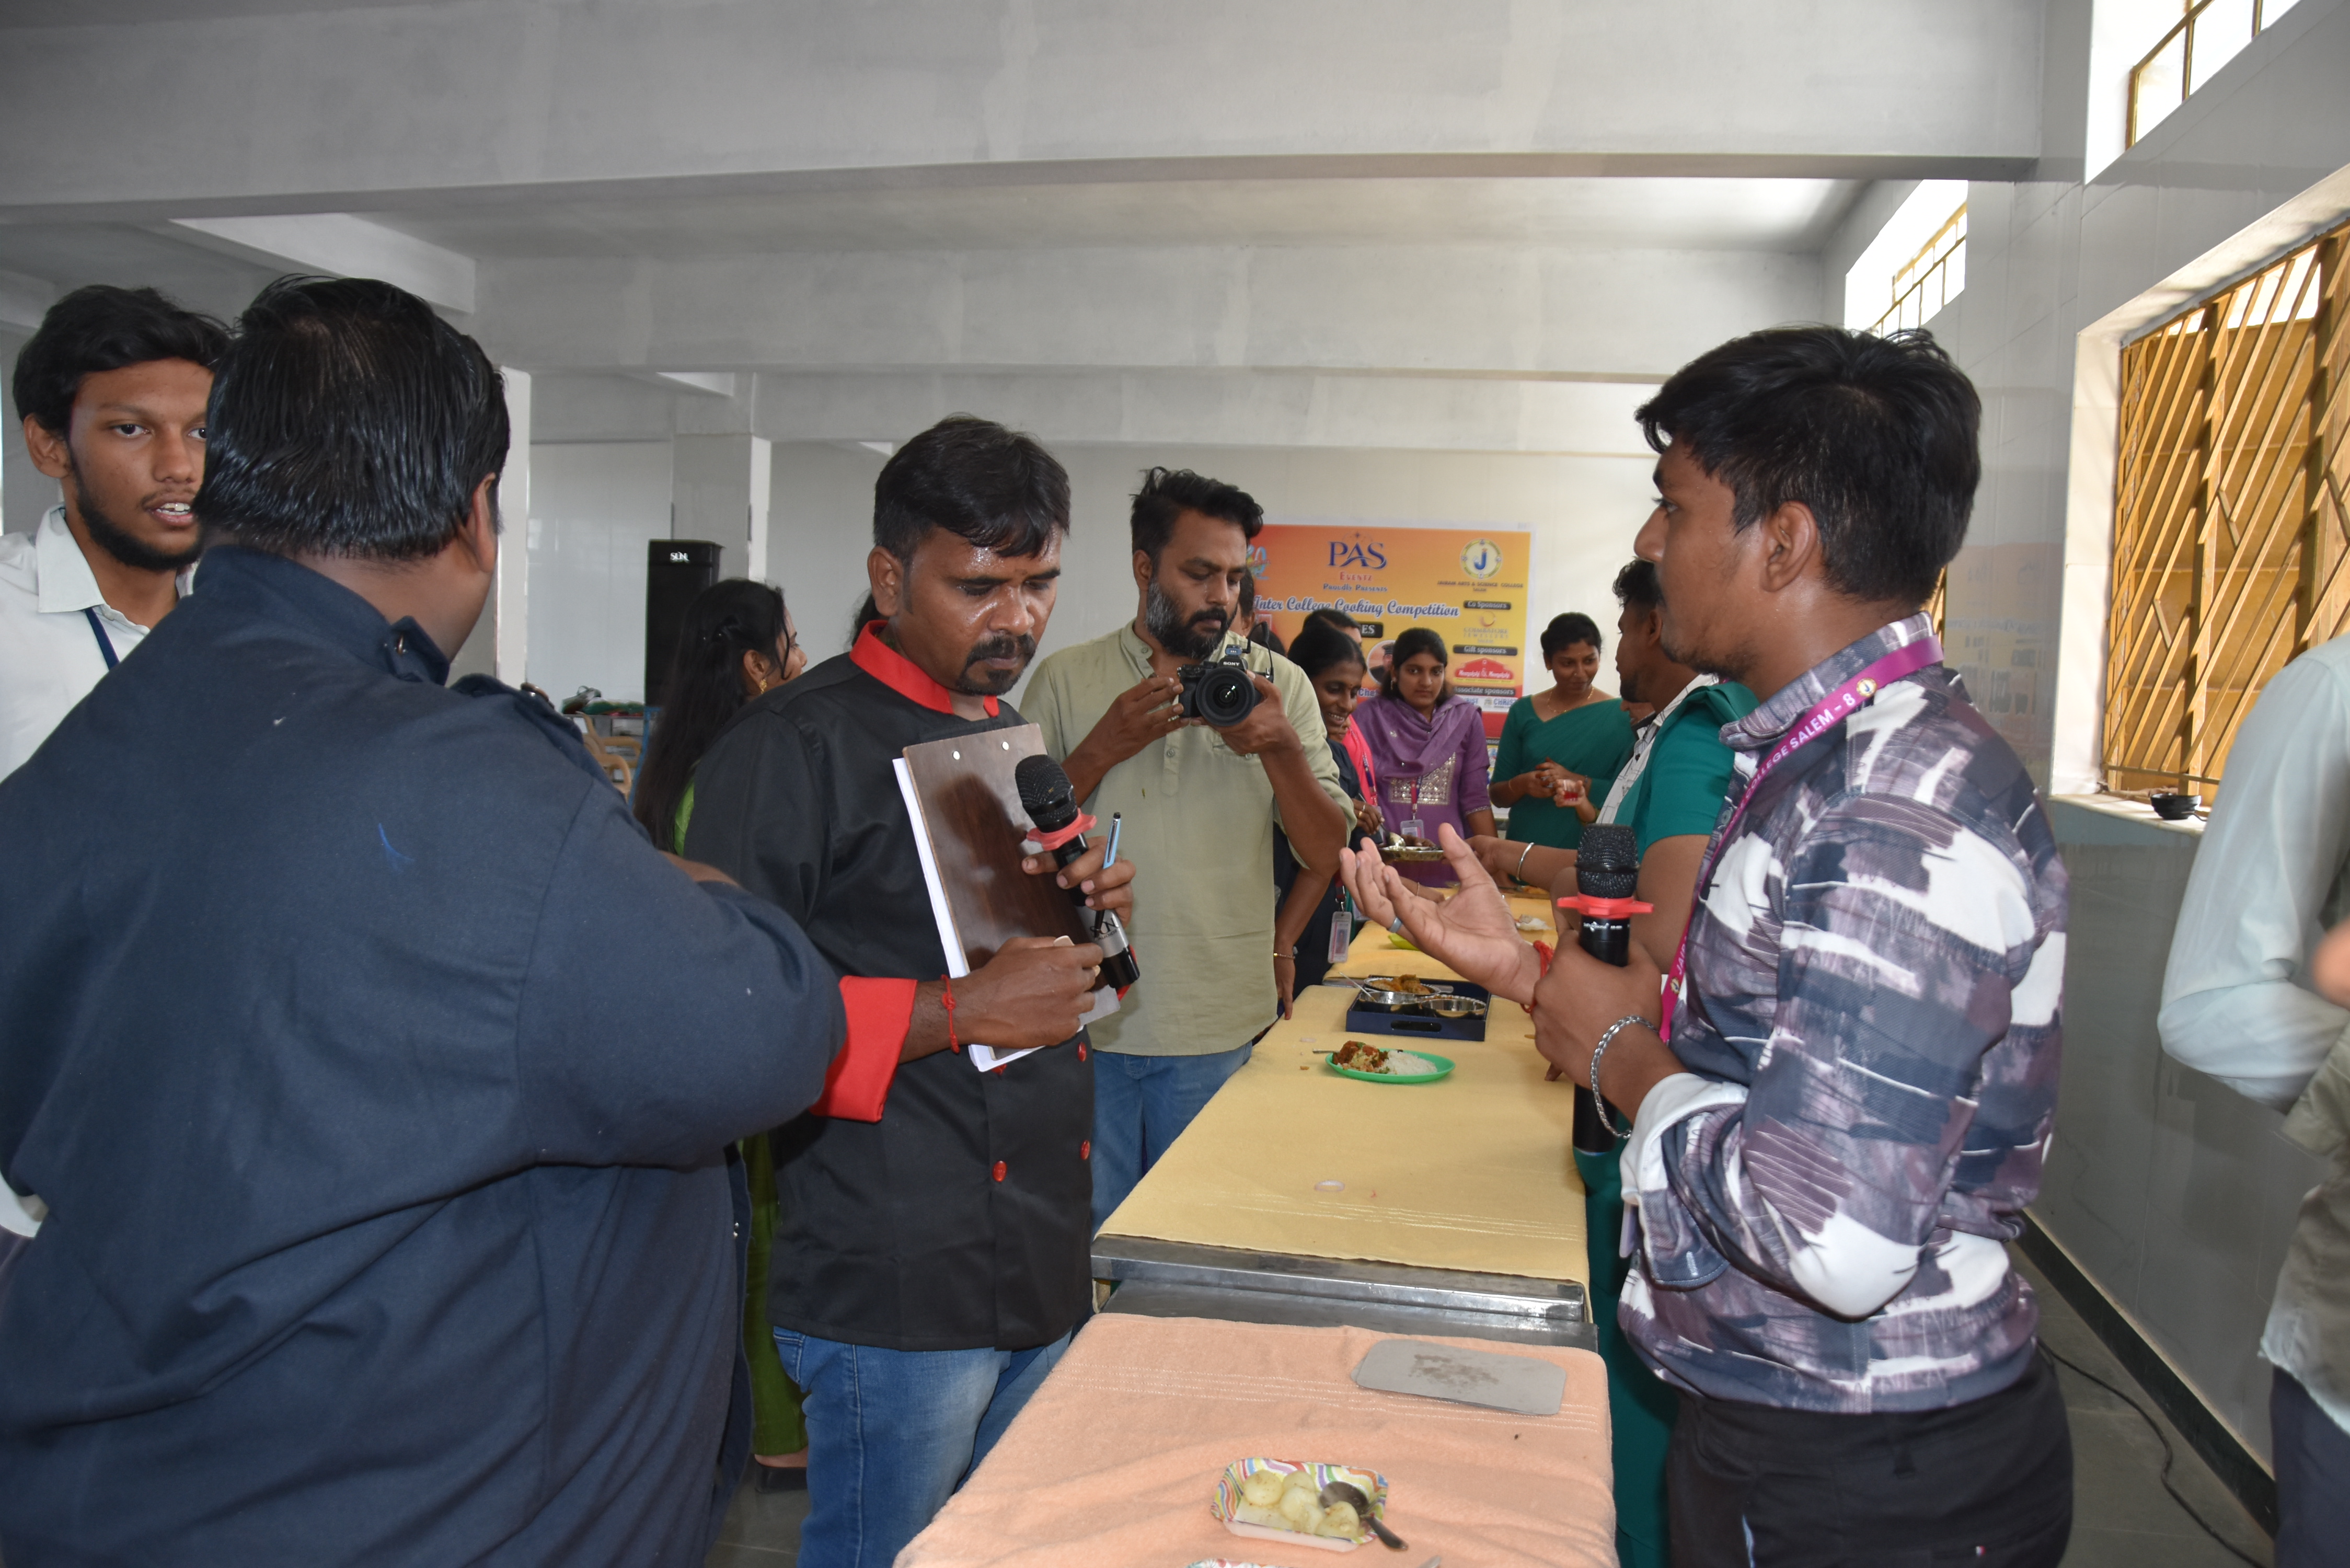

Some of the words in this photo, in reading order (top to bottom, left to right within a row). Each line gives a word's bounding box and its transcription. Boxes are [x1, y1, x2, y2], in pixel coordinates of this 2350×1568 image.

[1328, 541, 1387, 569] PAS
[1254, 595, 1283, 610] Inter
[1334, 598, 1384, 618] Cooking
[1387, 600, 1460, 619] Competition
[1789, 708, 1835, 749] SALEM
[1842, 693, 1856, 706] 8
